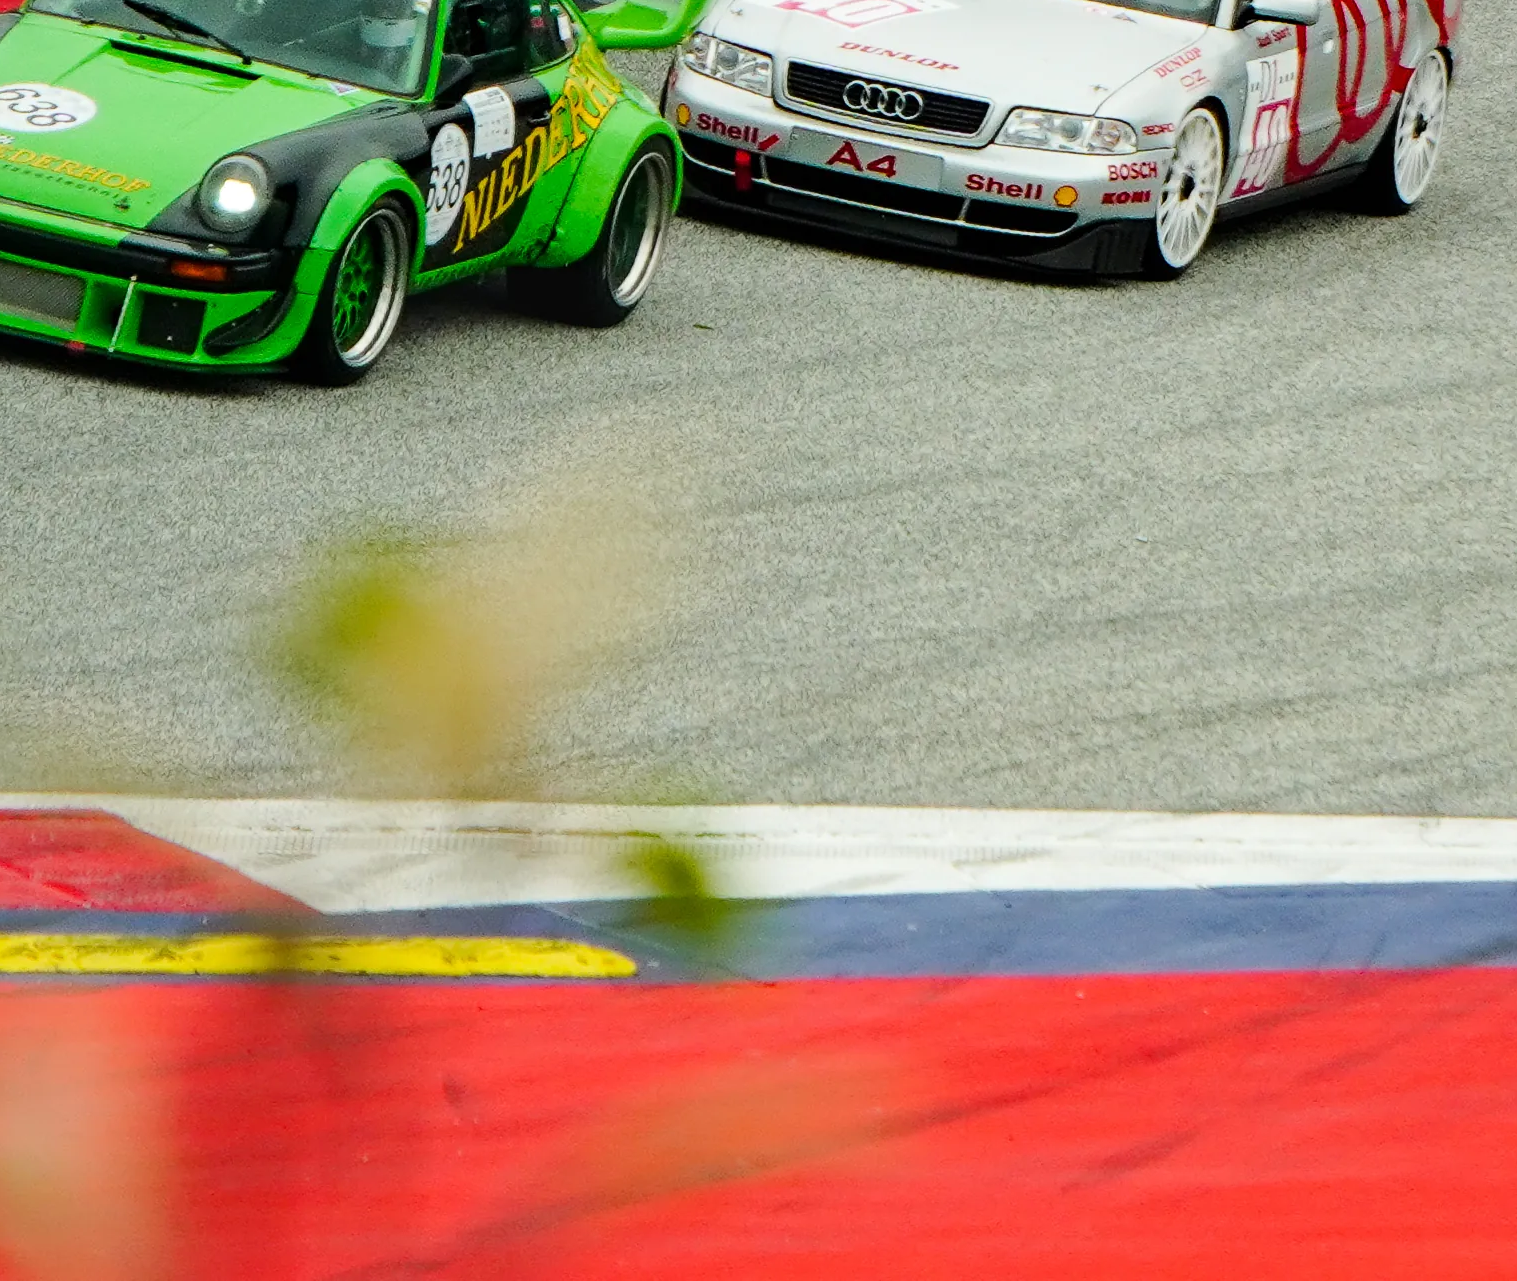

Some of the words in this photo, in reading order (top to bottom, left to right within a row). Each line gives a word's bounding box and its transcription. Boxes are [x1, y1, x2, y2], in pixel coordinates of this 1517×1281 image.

[838, 41, 961, 70] DUNLOP
[1153, 47, 1202, 79] DUNLOP
[696, 112, 760, 145] Shell
[825, 140, 897, 178] A4
[1107, 161, 1159, 183] BOSCH
[964, 173, 1044, 200] Shell
[1100, 189, 1152, 205] KONI
